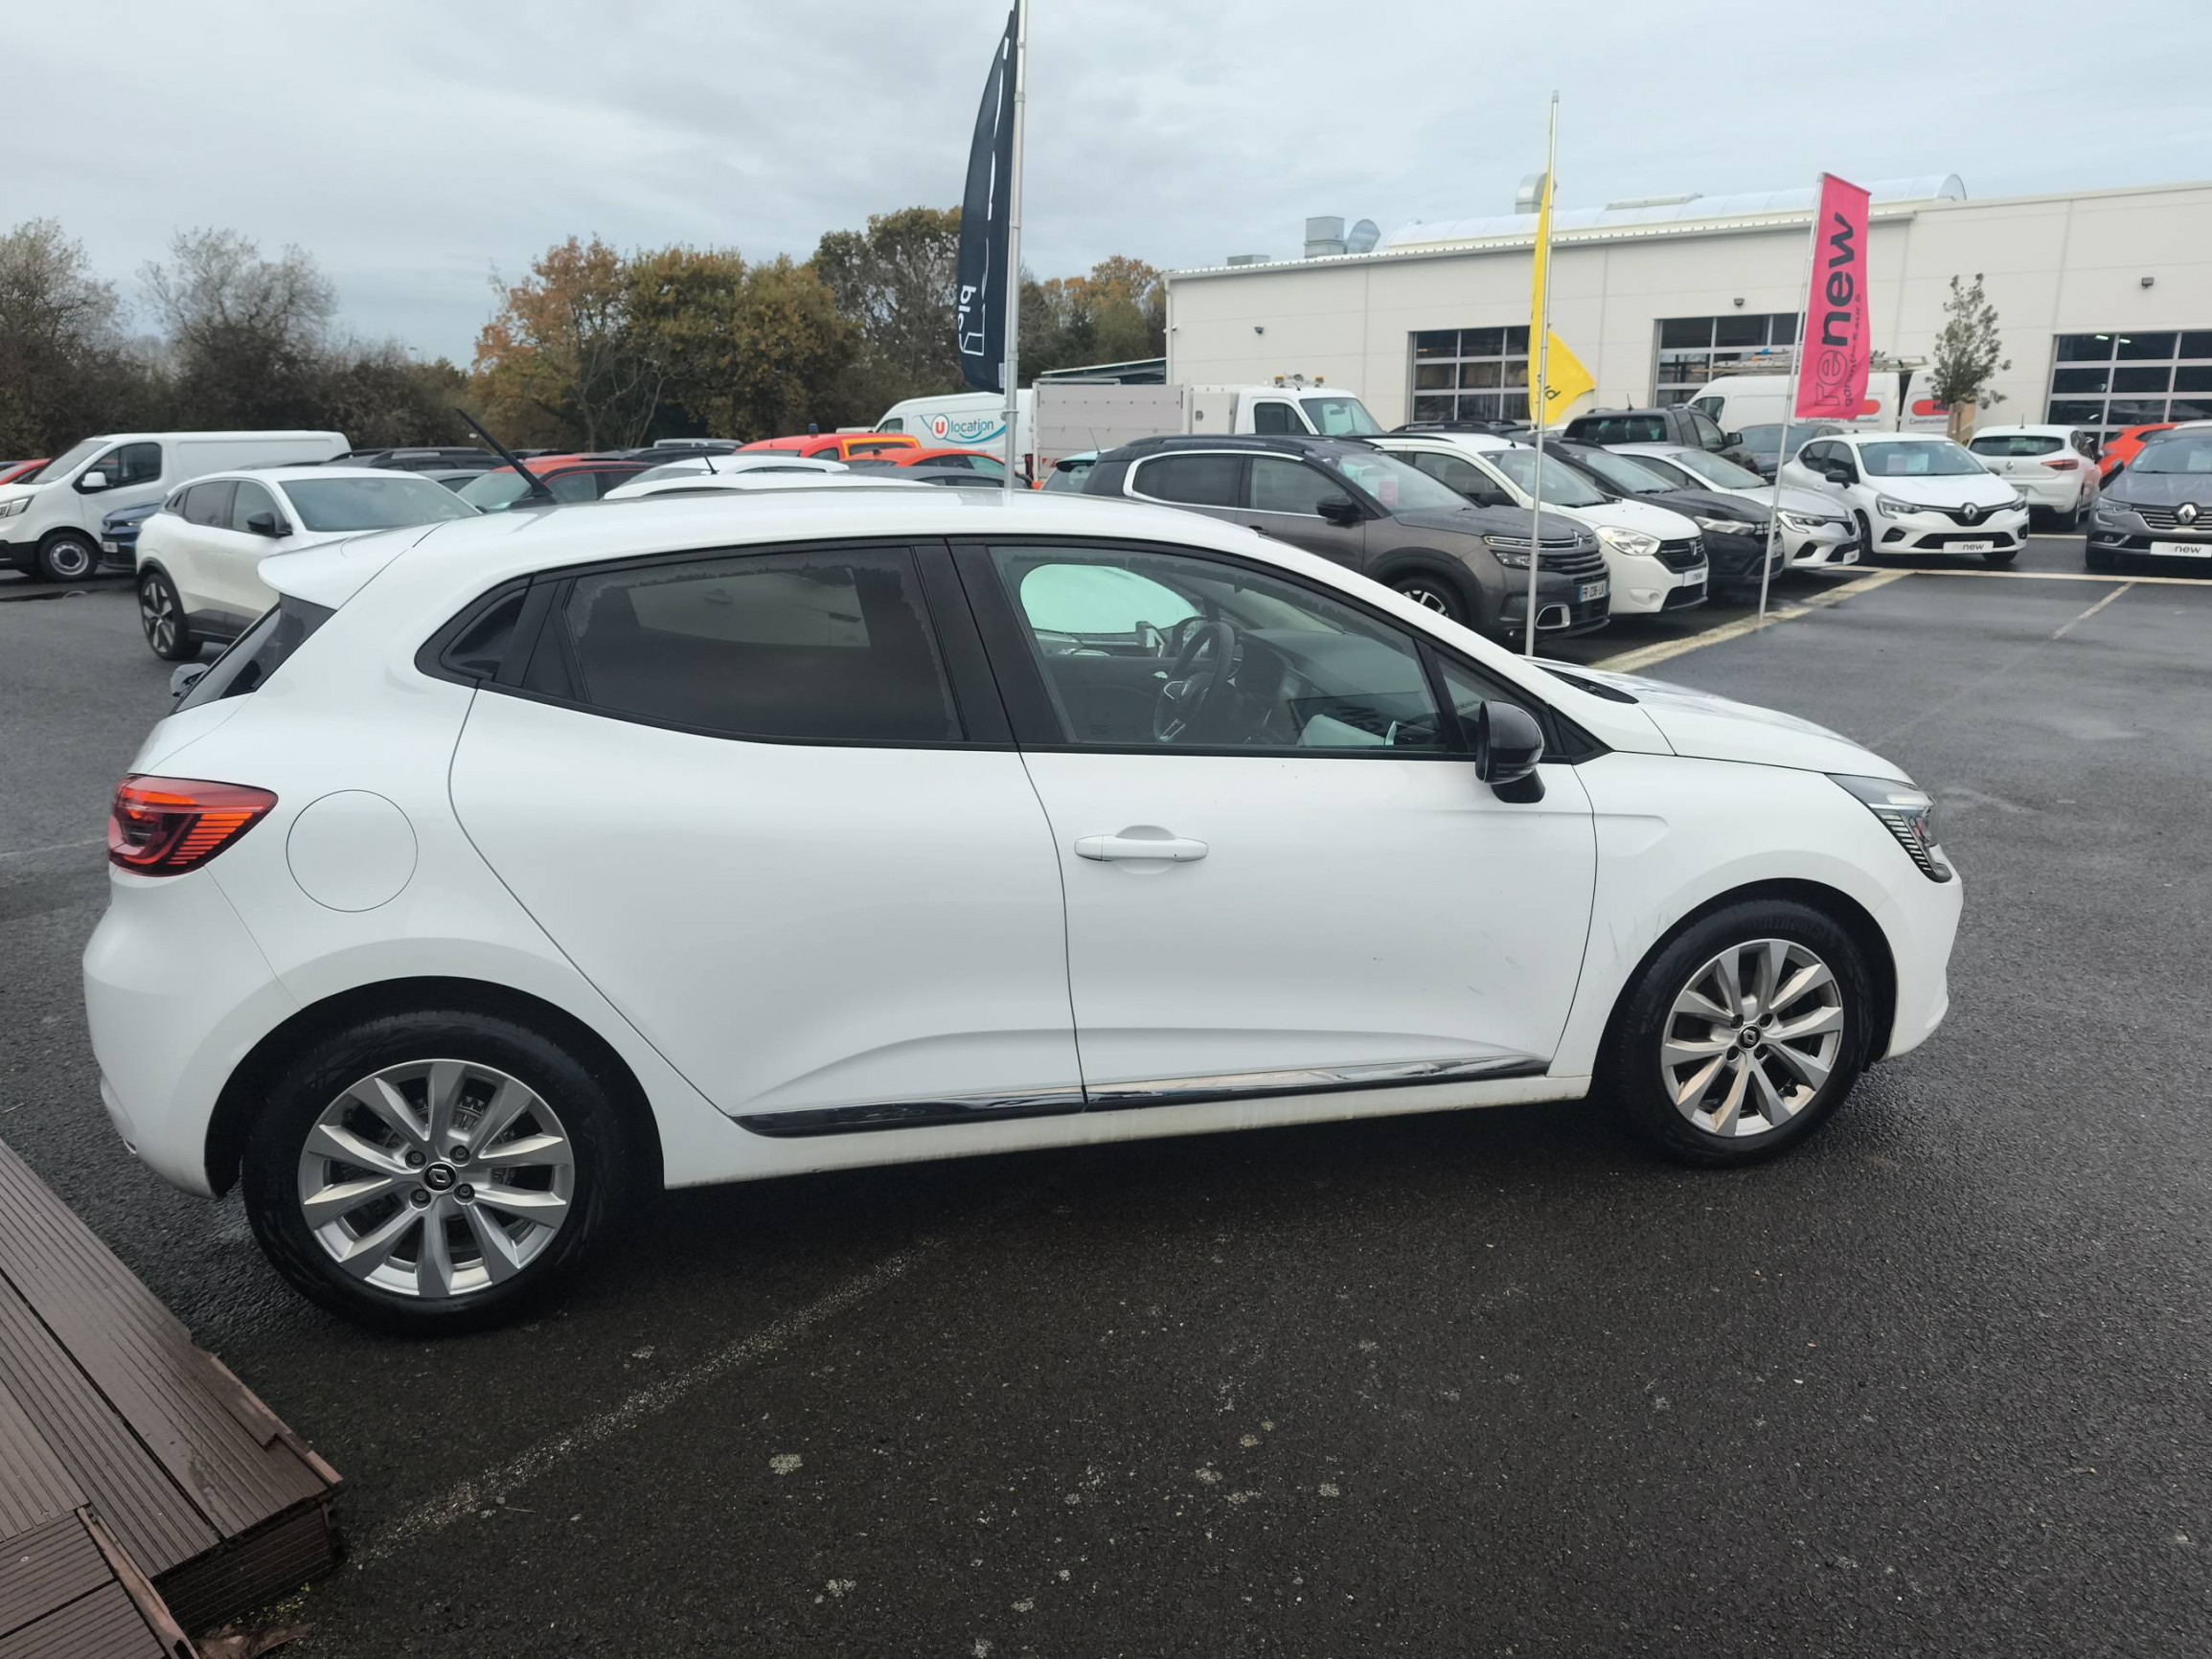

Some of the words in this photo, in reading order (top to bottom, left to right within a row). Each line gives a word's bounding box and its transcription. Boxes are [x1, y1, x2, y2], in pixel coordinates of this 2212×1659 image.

[1814, 212, 1855, 407] renew
[935, 421, 946, 434] U
[951, 419, 994, 434] location
